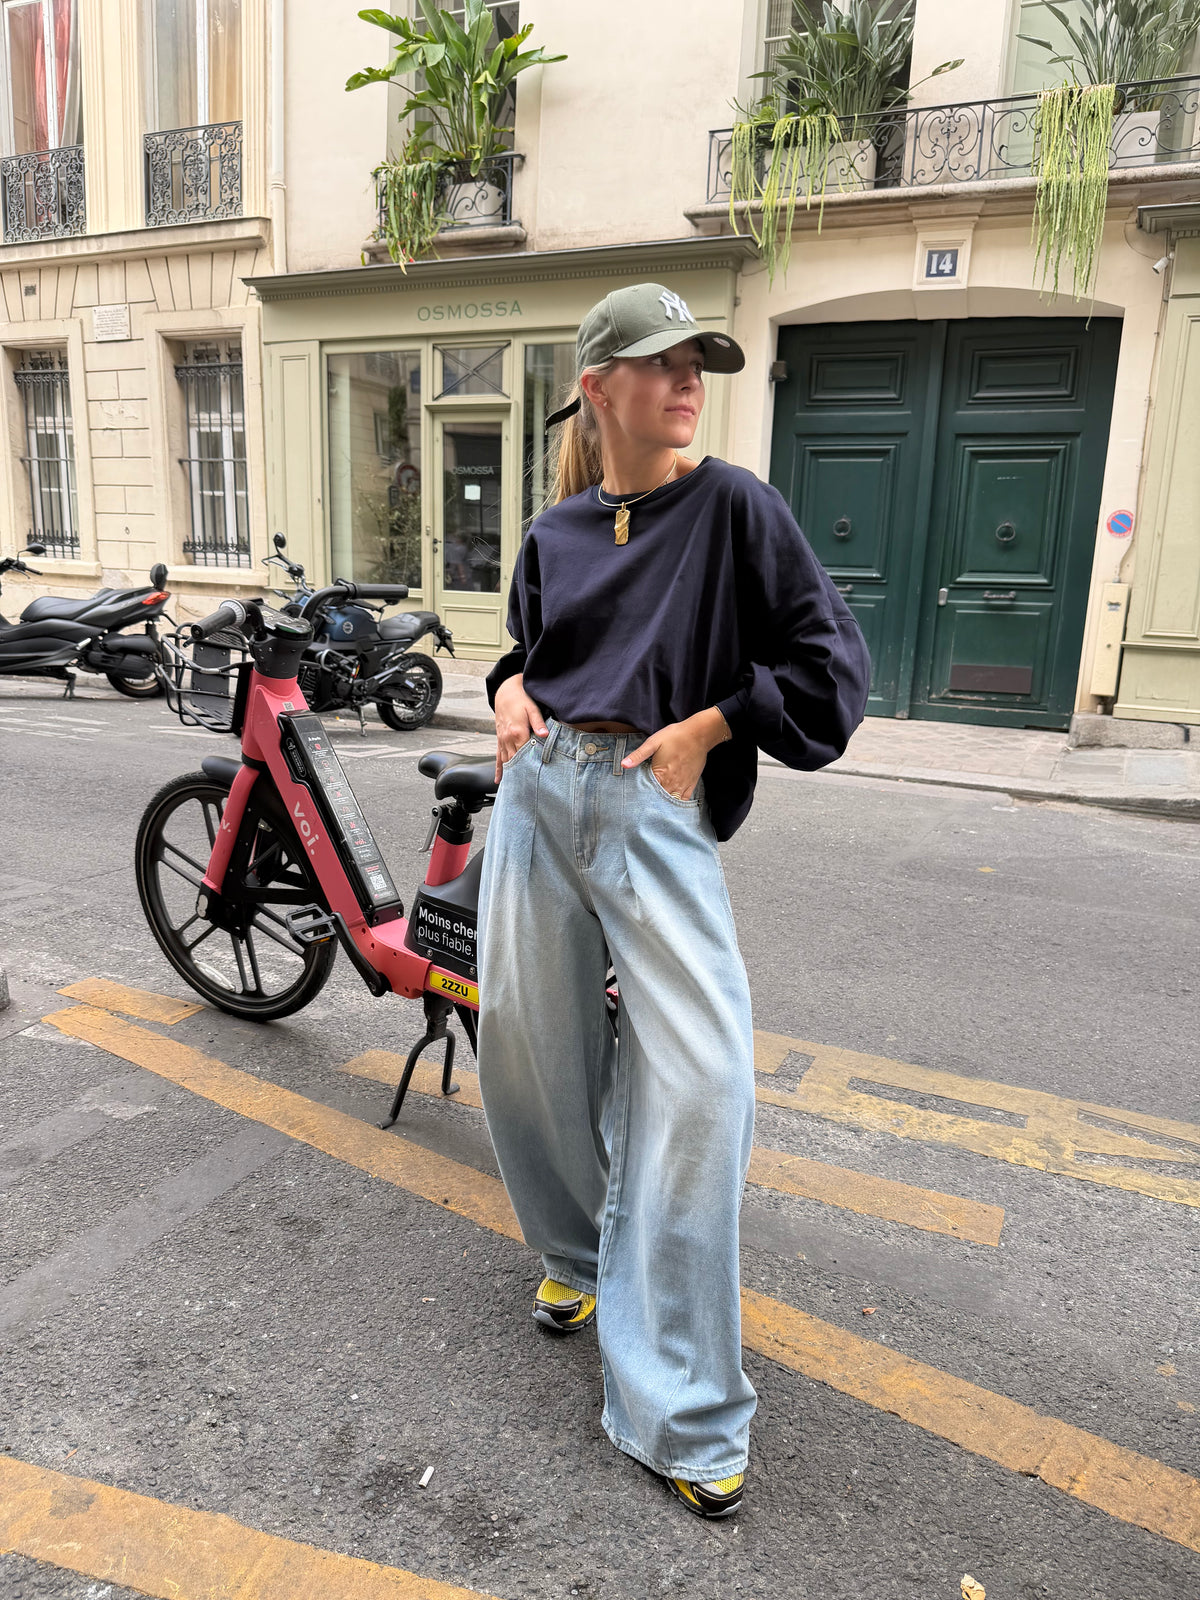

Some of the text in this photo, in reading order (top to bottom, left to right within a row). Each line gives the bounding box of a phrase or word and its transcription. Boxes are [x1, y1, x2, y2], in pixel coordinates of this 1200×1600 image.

[930, 253, 953, 274] 14
[417, 300, 523, 321] OSMOSSA
[658, 291, 695, 324] NY
[452, 465, 495, 475] OSMOSSA
[418, 906, 451, 930] Moins
[417, 925, 474, 957] plus fiable.
[441, 978, 469, 997] 2ZZU
